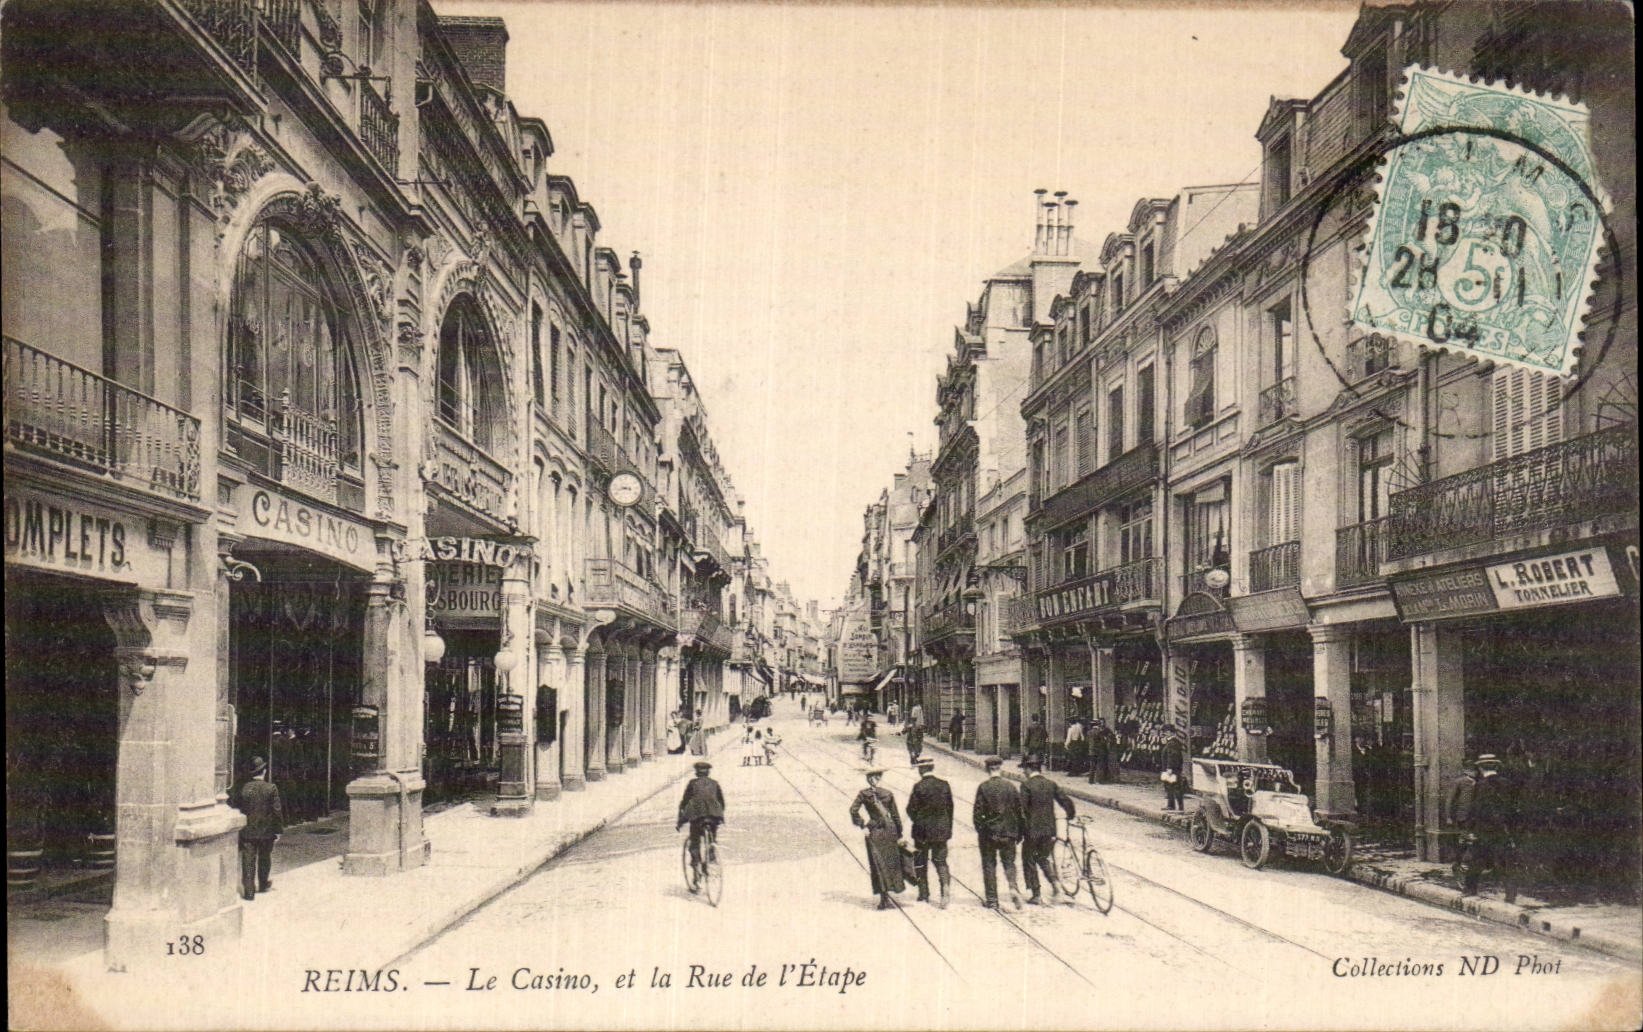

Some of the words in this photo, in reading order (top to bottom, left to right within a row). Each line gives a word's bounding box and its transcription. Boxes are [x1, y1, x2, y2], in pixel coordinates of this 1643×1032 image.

[1409, 311, 1508, 353] POES
[252, 490, 359, 554] CASINO
[1436, 573, 1484, 595] ATELIERS
[1514, 553, 1595, 586] ROBERT
[1514, 580, 1594, 602] TONNELIER
